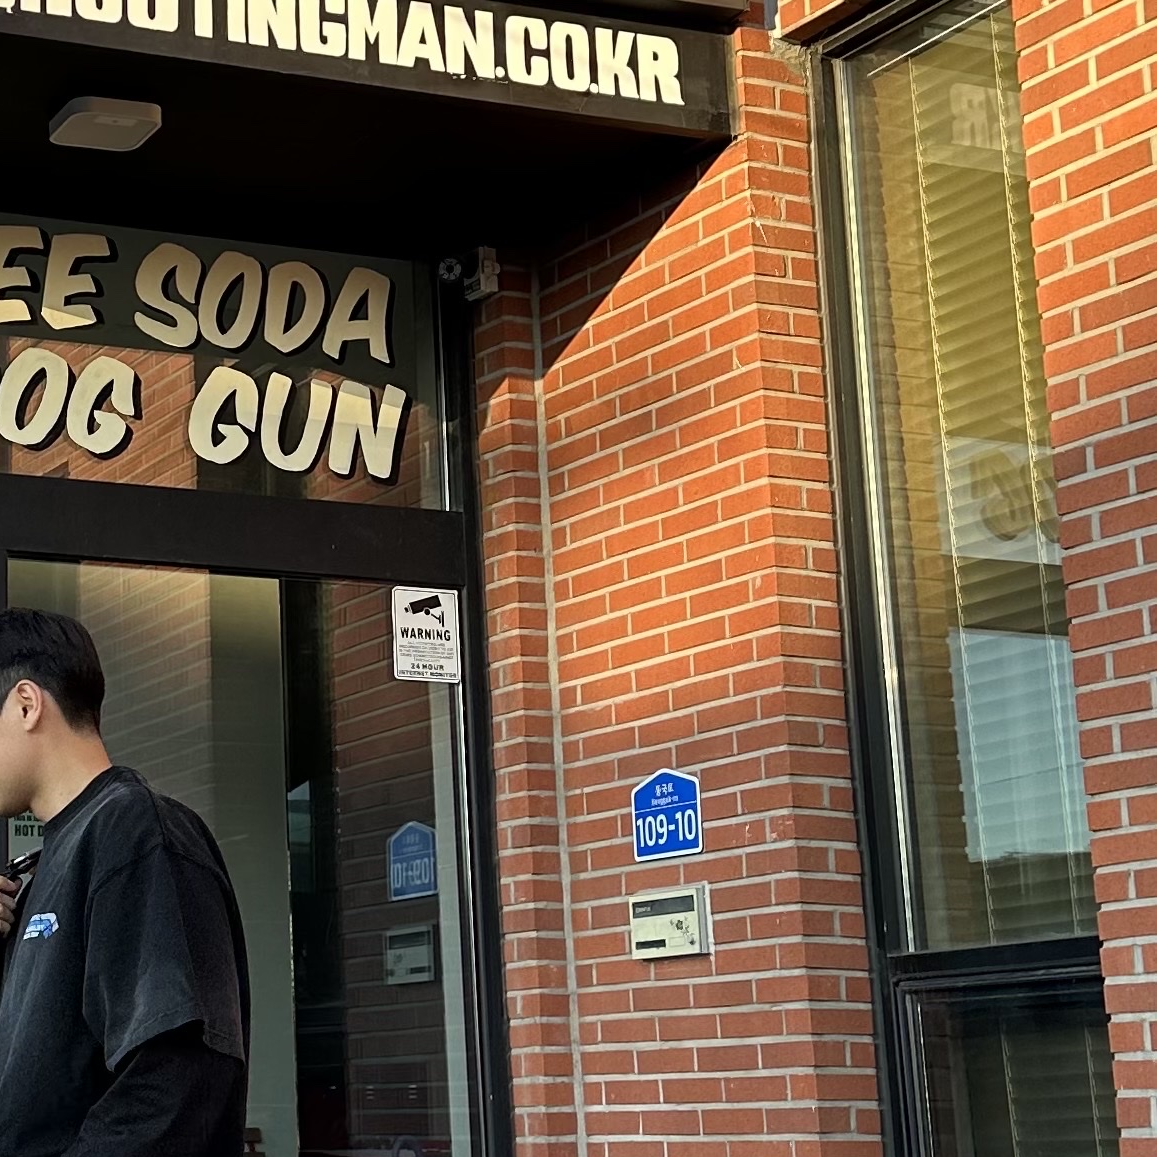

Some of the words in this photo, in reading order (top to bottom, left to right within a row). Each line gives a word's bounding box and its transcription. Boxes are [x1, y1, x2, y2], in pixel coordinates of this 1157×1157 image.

[133, 241, 396, 367] SODA
[189, 366, 409, 480] GUN
[400, 627, 451, 641] WARNING
[14, 824, 35, 837] HOT
[636, 809, 697, 848] 109-10
